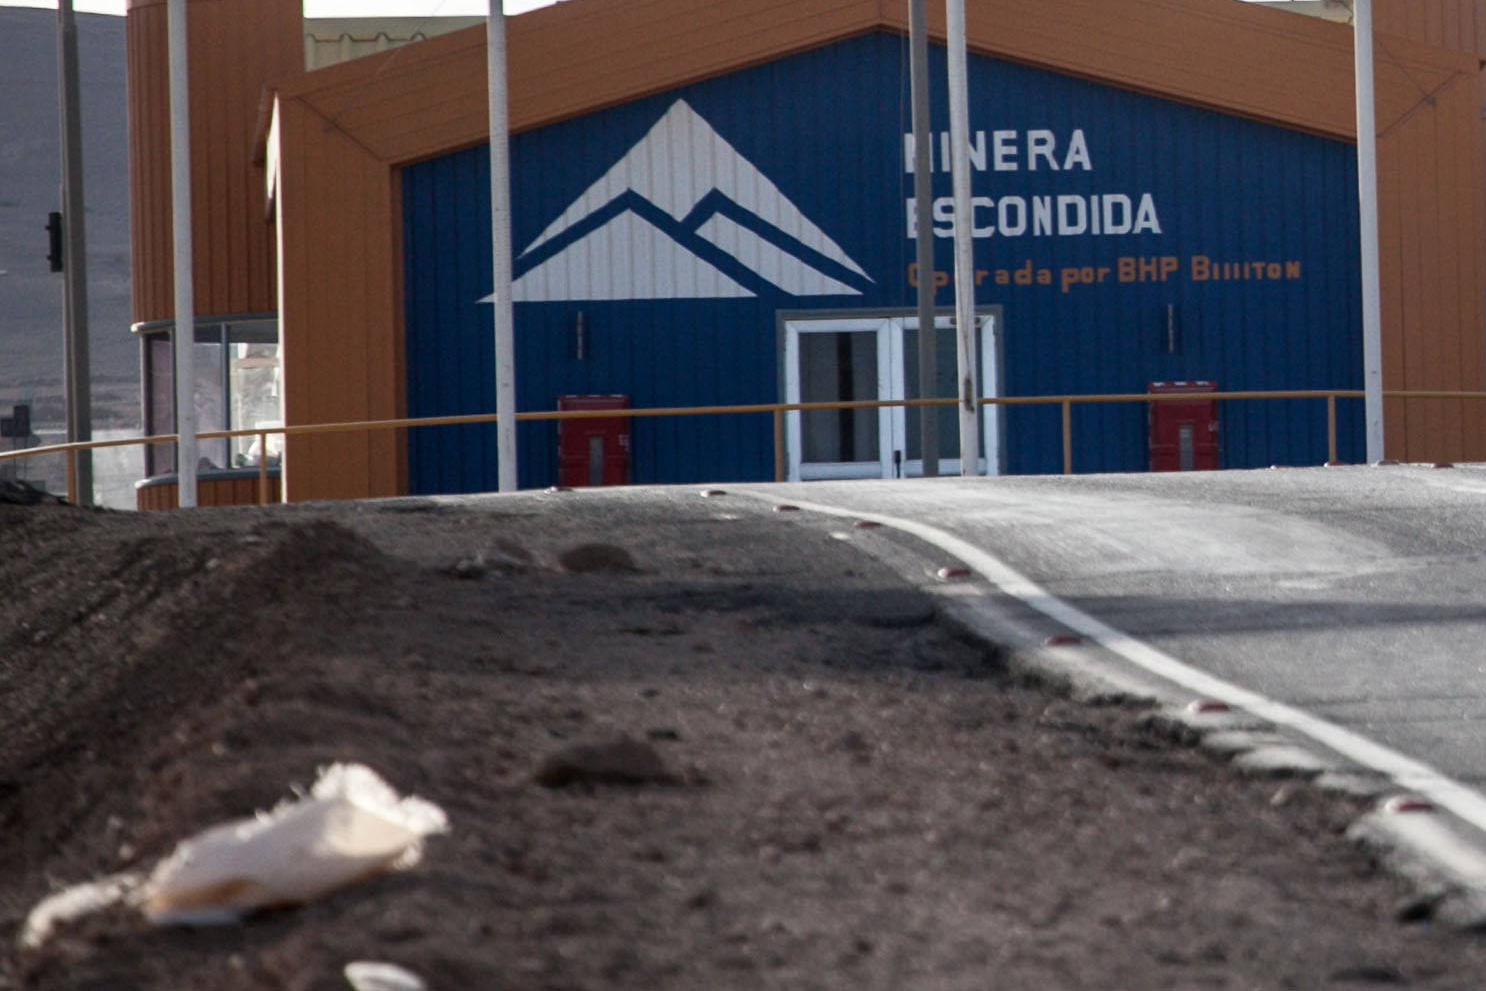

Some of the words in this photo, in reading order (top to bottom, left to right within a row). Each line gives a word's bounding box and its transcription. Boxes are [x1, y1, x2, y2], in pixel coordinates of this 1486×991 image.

[907, 259, 1052, 298] Oprada
[1061, 266, 1111, 294] por
[1118, 256, 1178, 282] BHP
